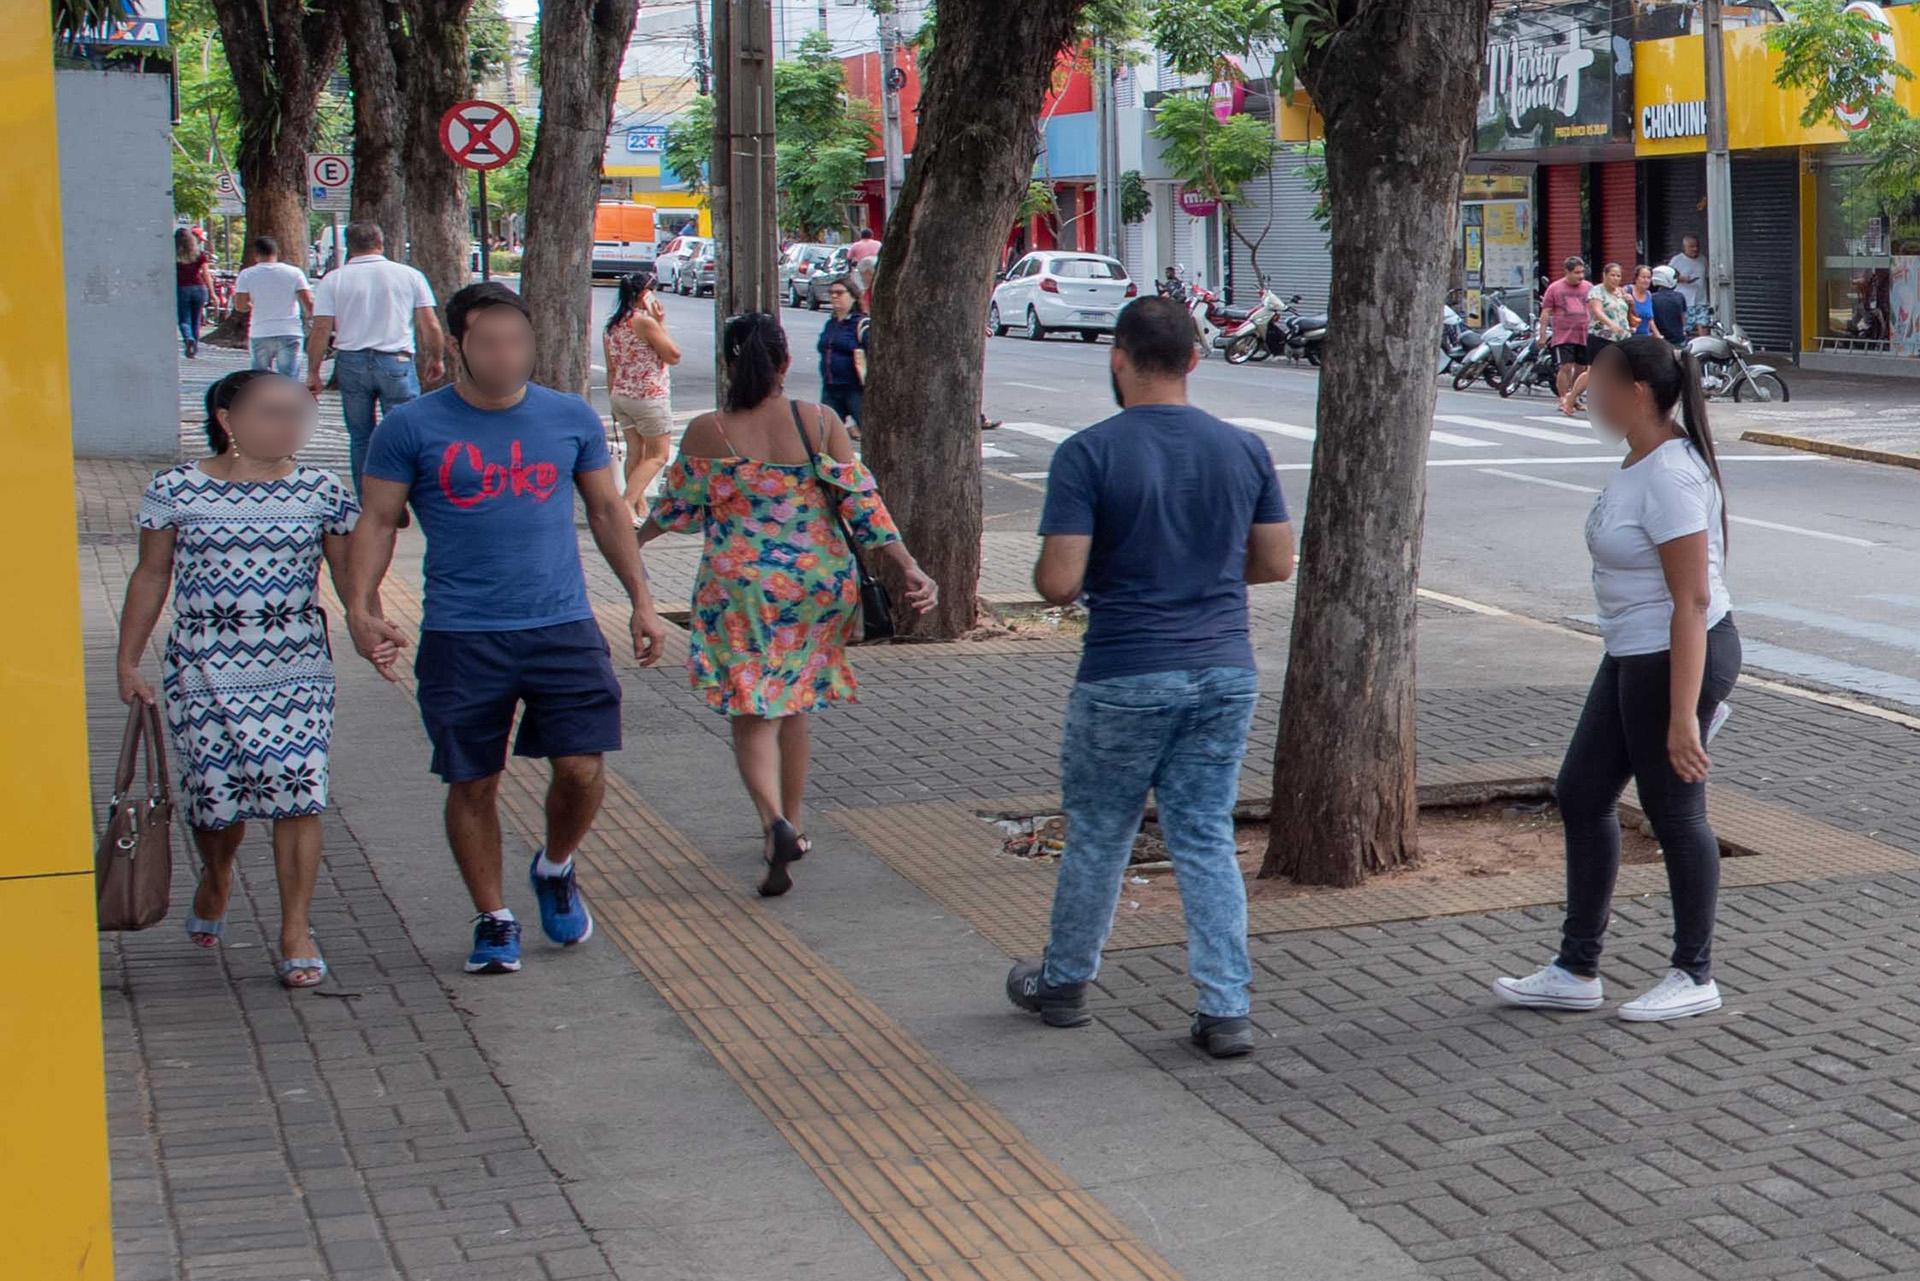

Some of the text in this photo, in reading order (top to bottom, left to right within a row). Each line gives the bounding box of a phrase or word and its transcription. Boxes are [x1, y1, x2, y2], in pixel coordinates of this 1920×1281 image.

[325, 163, 338, 180] E
[221, 178, 230, 189] E
[439, 440, 558, 508] Coke
